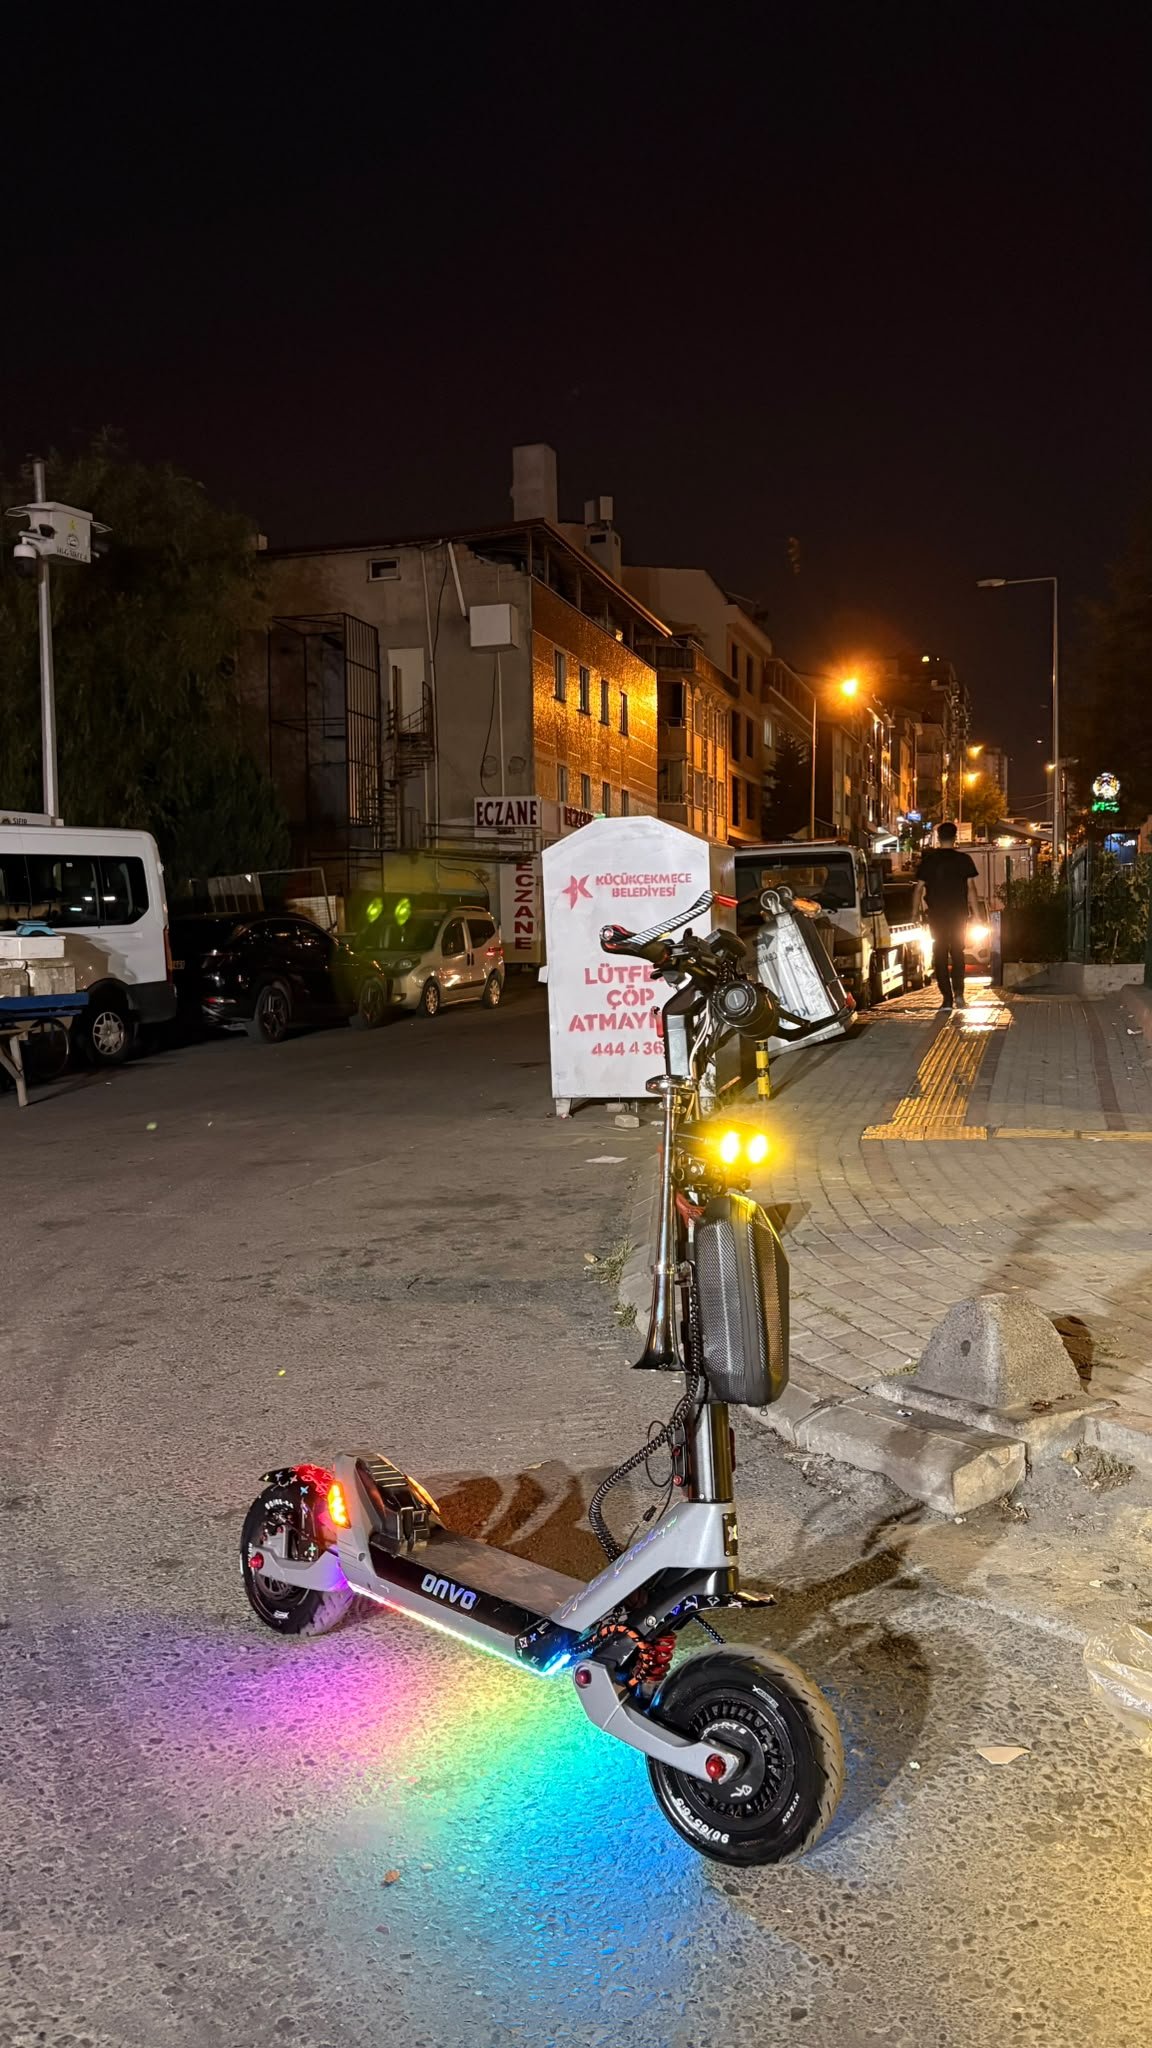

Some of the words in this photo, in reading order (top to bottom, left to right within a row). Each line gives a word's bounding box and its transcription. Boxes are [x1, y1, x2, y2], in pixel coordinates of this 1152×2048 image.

[476, 801, 537, 826] ECZANE
[595, 872, 692, 886] KÜÇÜKÇEKMECE
[612, 885, 676, 898] BELEDİYESİ
[514, 857, 534, 950] ECZANE
[584, 963, 665, 985] LÜTFE
[606, 984, 655, 1010] ÇÖP
[568, 1012, 657, 1032] ATMAYI
[591, 1042, 625, 1056] 444
[629, 1041, 640, 1055] 4
[642, 1041, 665, 1056] 36
